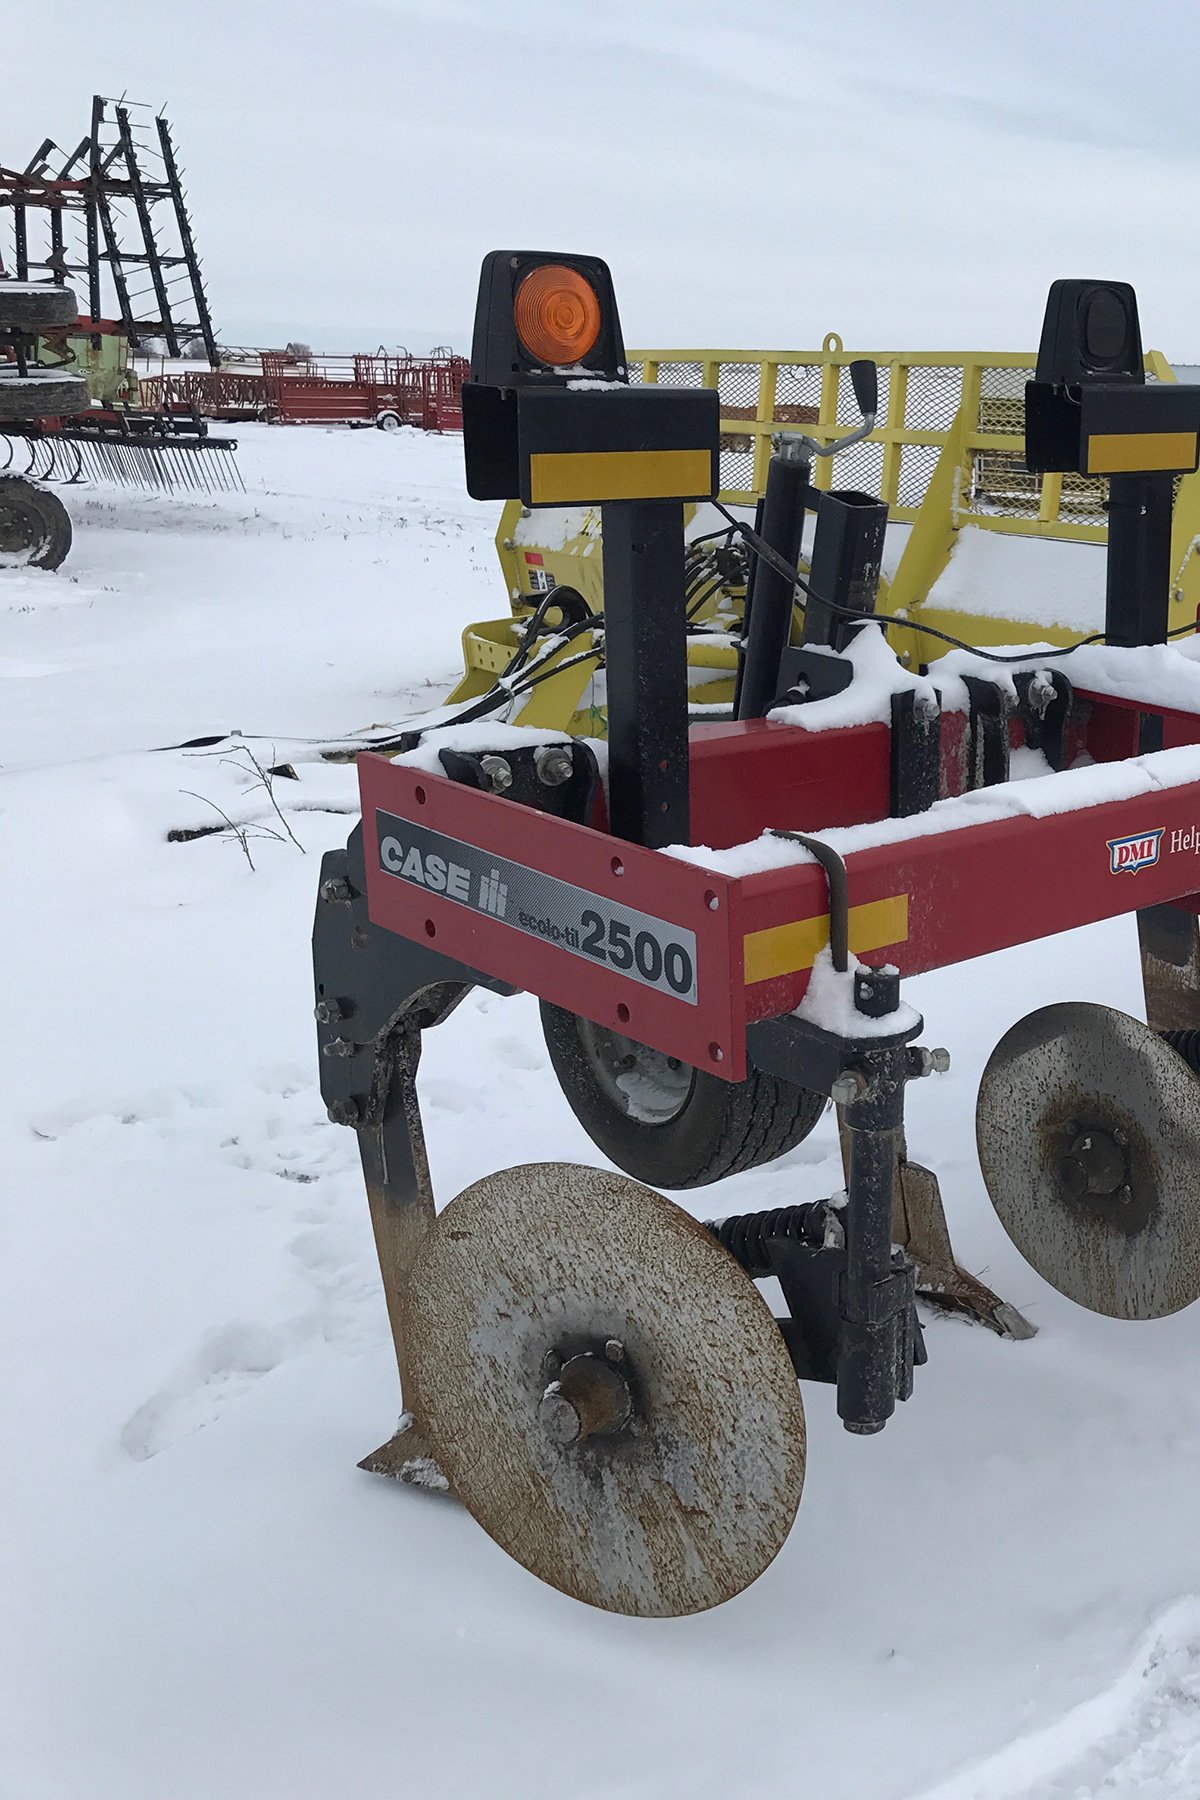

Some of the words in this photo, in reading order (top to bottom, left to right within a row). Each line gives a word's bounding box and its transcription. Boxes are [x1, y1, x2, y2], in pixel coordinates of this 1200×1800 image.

[1117, 839, 1155, 865] DMI
[380, 836, 471, 902] CASE
[580, 909, 693, 995] 2500
